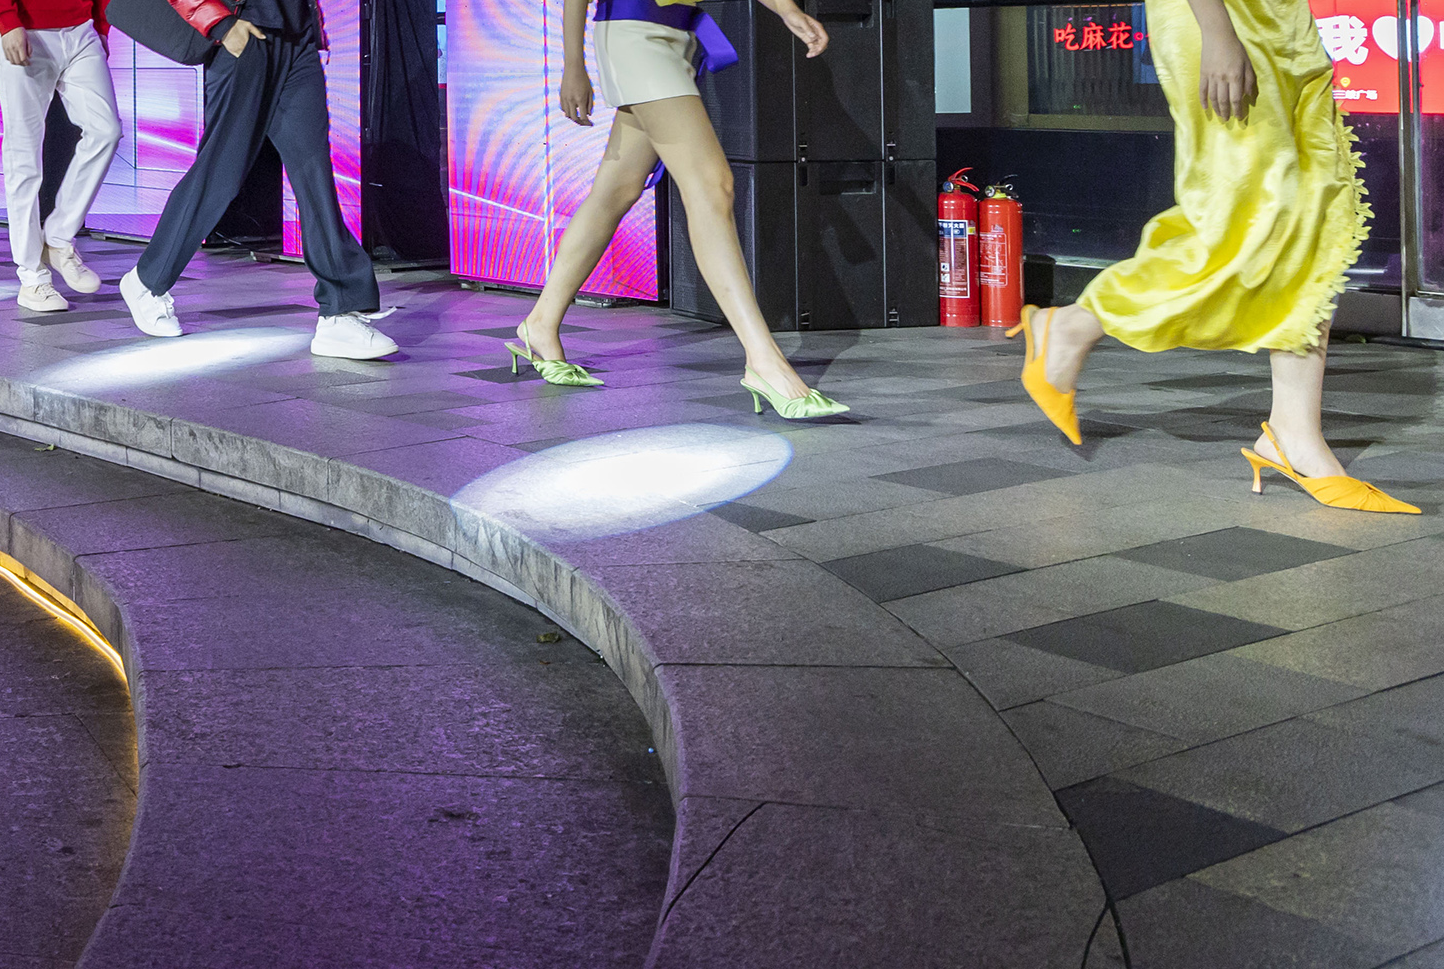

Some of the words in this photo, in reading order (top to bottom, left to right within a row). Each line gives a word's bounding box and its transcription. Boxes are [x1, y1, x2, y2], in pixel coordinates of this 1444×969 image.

[1053, 21, 1134, 51] 吃麻花
[1315, 15, 1369, 65] 我
